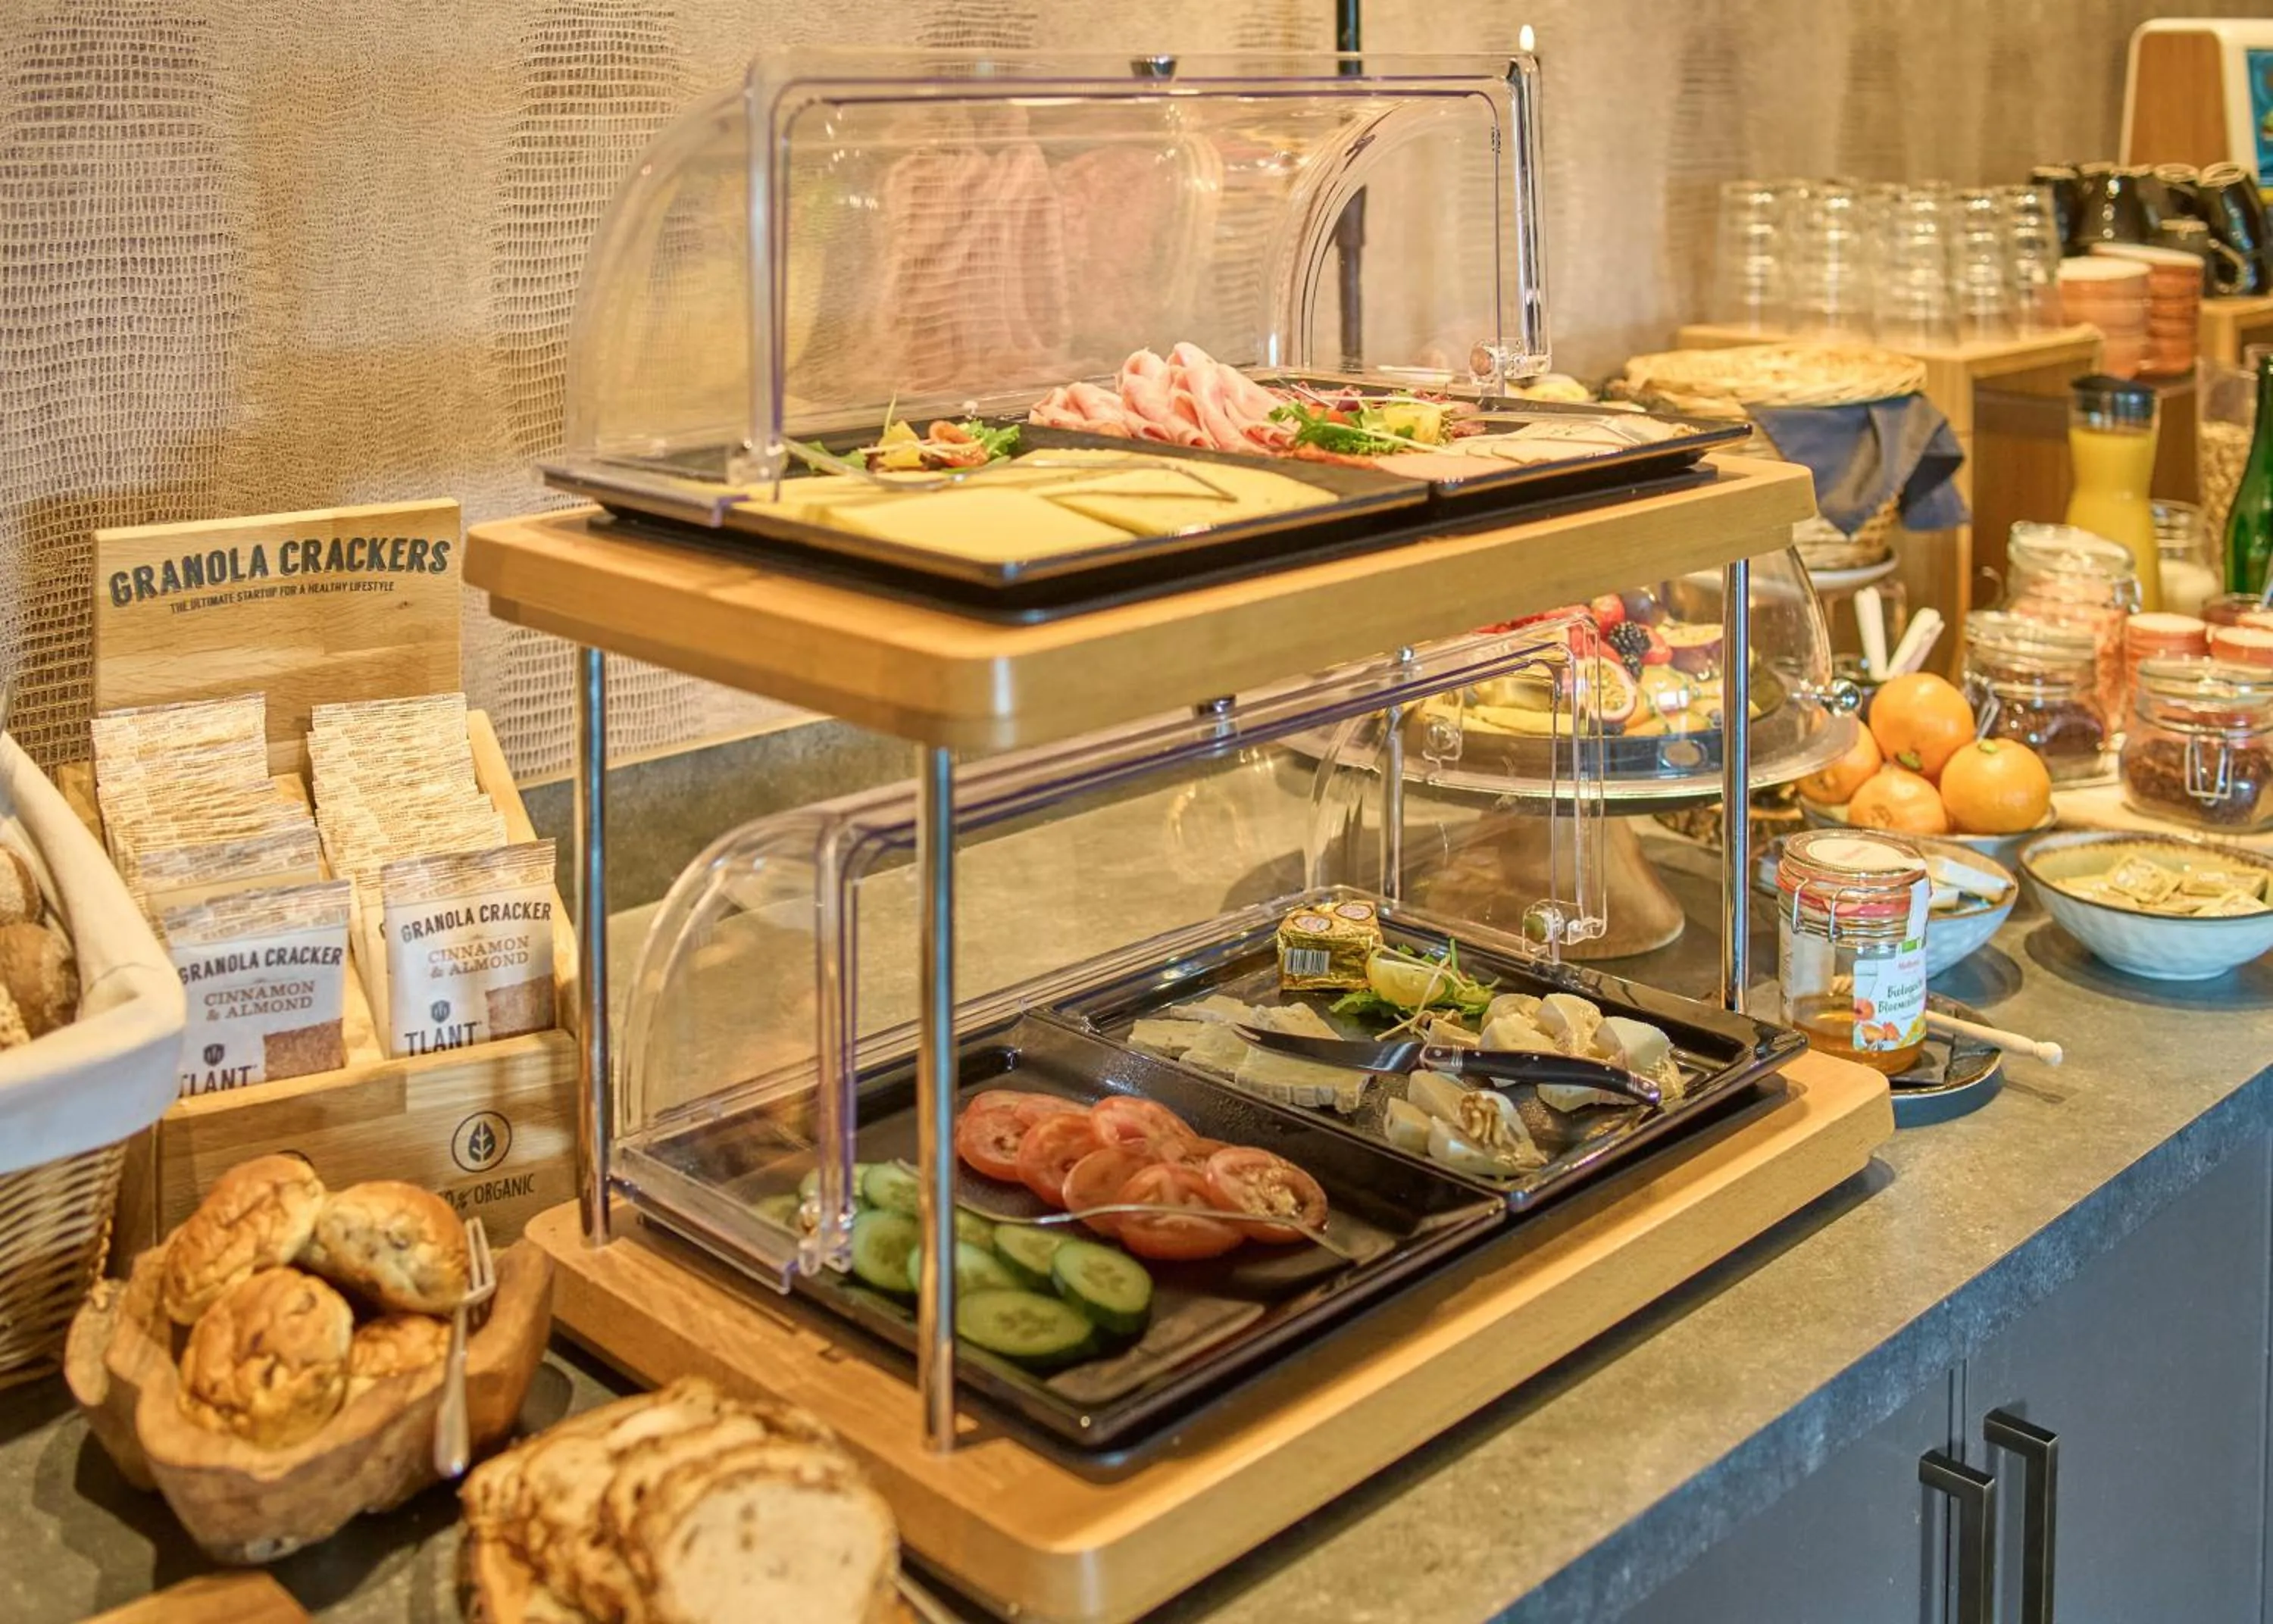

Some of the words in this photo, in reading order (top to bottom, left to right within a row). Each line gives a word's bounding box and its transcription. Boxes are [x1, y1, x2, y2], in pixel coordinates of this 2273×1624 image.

[108, 544, 270, 607] GRANOLA
[279, 536, 451, 576] CRACKERS
[169, 601, 189, 614] THE
[190, 592, 235, 611] ULTIMATE
[236, 586, 277, 602] STARTUP
[280, 585, 297, 597] FOR
[299, 582, 305, 595] A
[308, 581, 348, 594] HEALTHY
[349, 581, 395, 592] LIFESTYLE
[401, 907, 475, 943] GRANOLA
[479, 901, 552, 923] CRACKER
[428, 935, 530, 963] CINNAMON
[178, 951, 260, 985] GRANOLA
[264, 946, 343, 967] CRACKER
[430, 966, 443, 979] &
[449, 951, 529, 976] ALMOND
[204, 980, 316, 1007] CINNAMON
[206, 1008, 220, 1022] &
[225, 995, 313, 1019] ALMOND
[474, 1173, 534, 1204] ORGANIC
